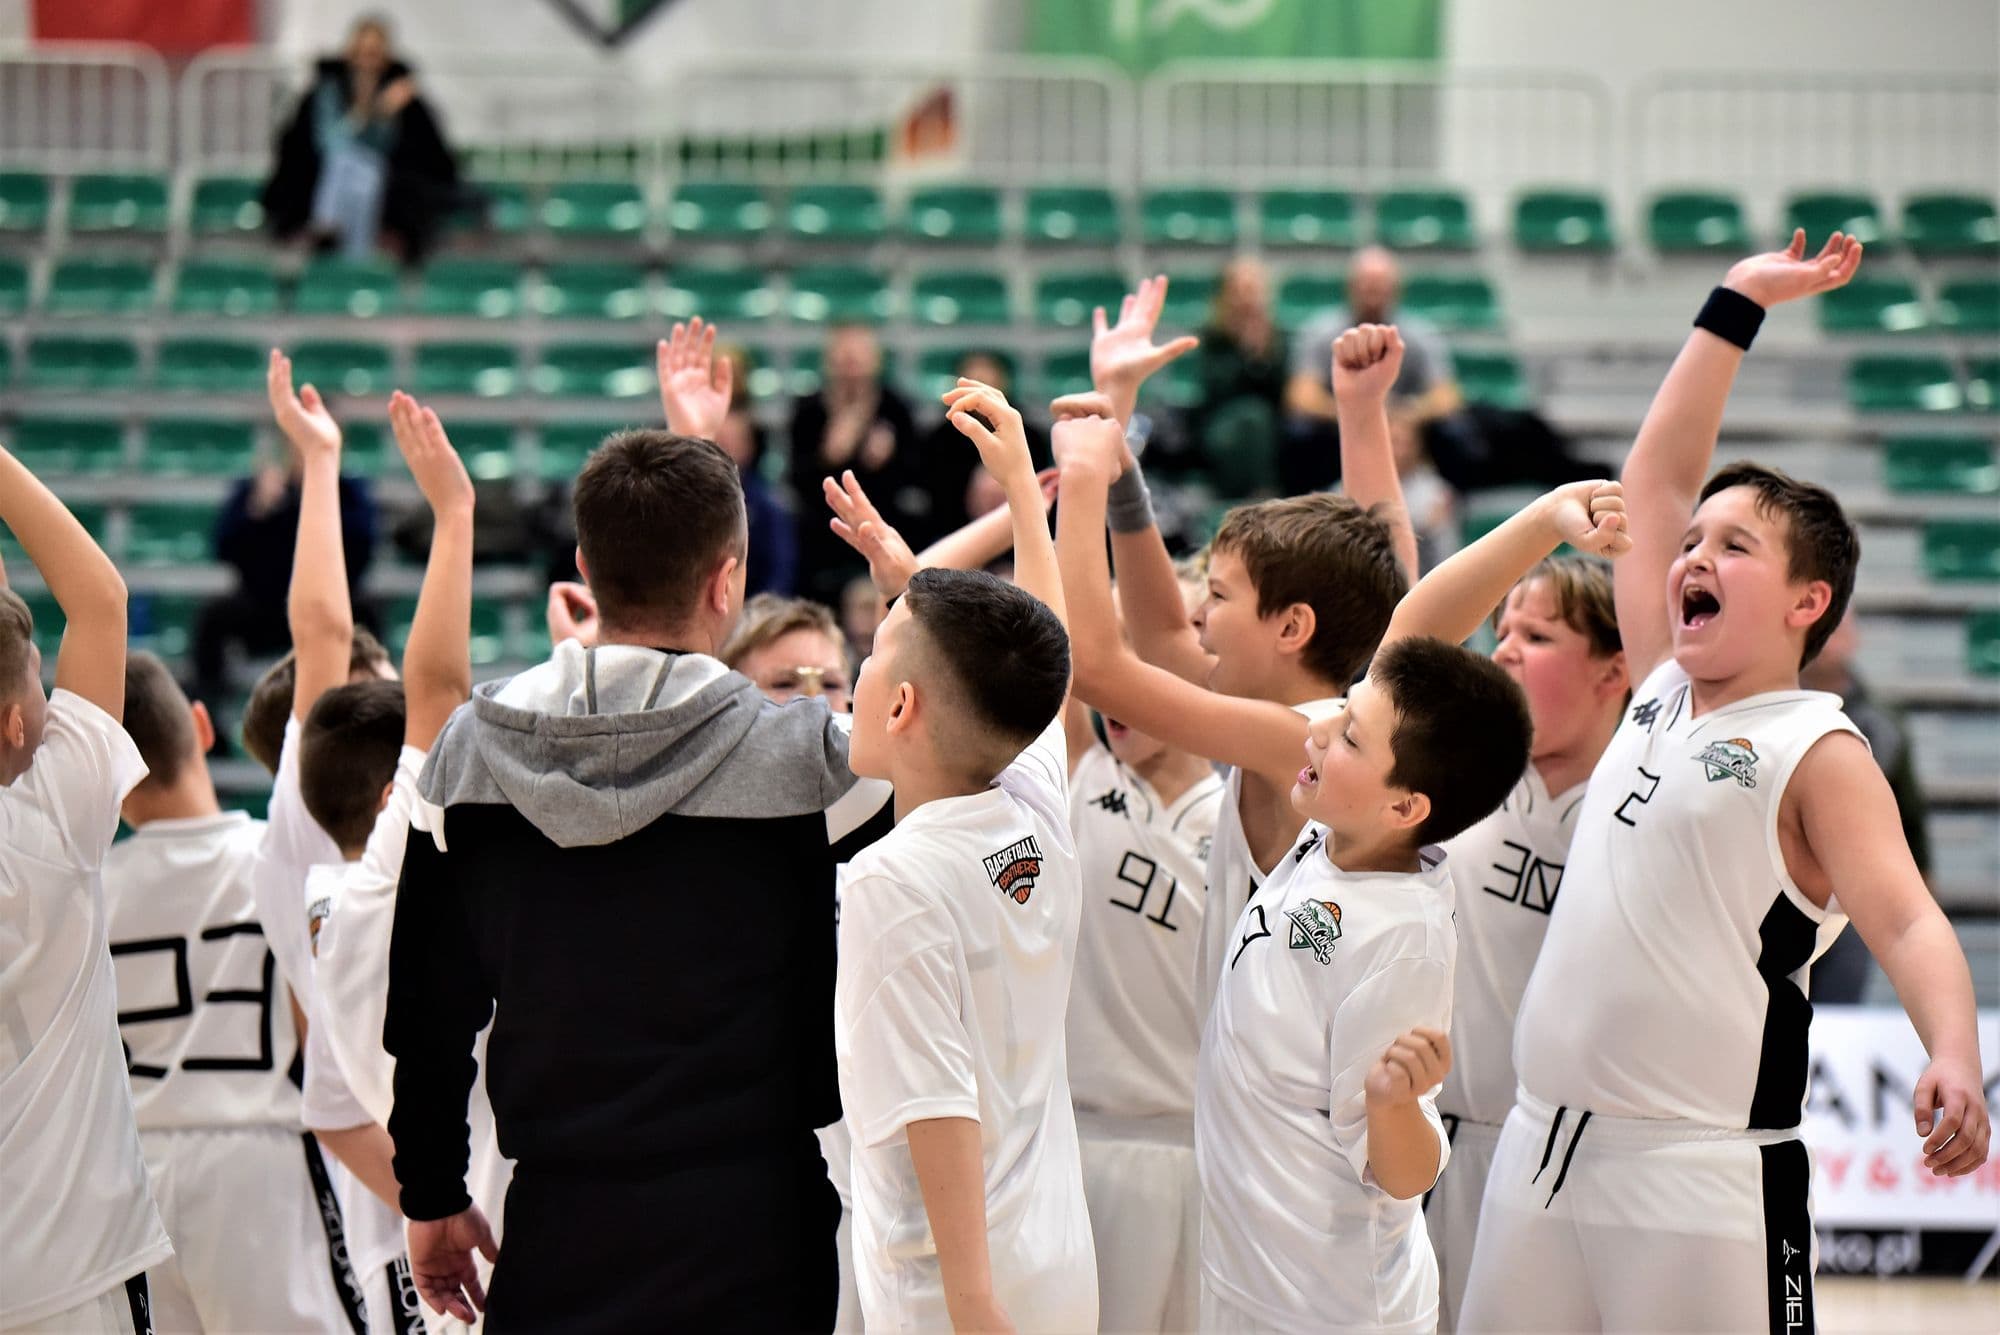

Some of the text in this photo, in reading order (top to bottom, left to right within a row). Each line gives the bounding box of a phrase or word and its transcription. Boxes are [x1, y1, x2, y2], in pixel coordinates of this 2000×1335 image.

[1614, 765, 1661, 828] 2
[983, 836, 1042, 883] BASKETBALL
[1109, 850, 1178, 932] 91
[1483, 839, 1566, 916] 30
[109, 922, 276, 1079] 23
